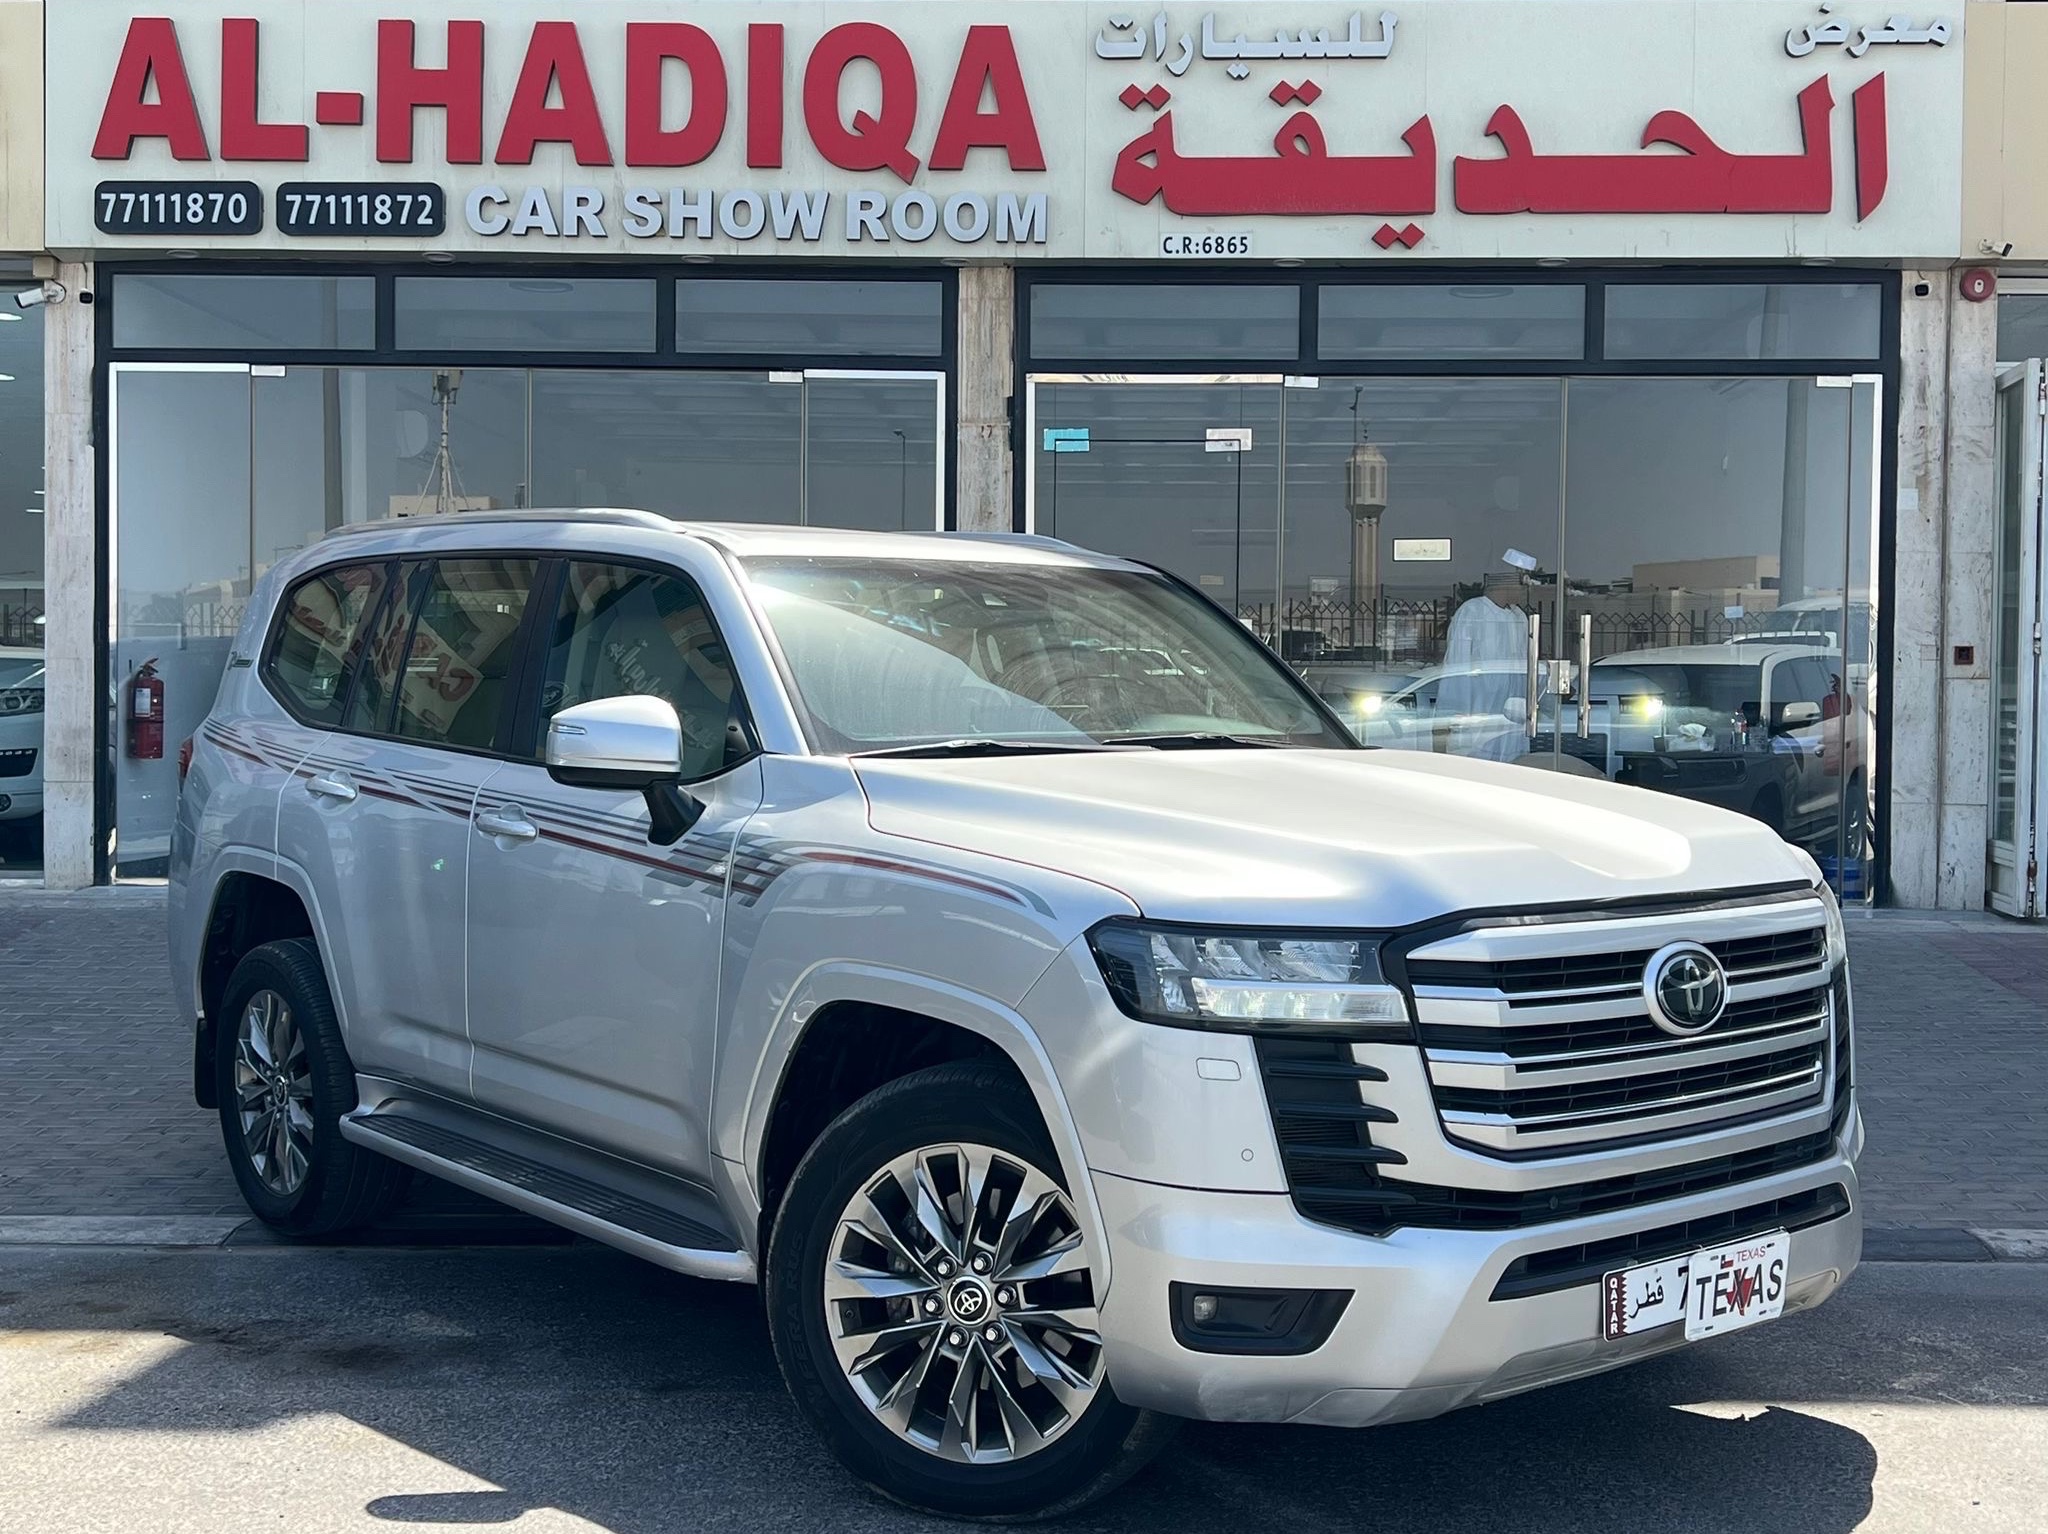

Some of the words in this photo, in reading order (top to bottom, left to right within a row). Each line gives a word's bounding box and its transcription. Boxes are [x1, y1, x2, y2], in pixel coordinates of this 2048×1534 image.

[1095, 10, 1399, 77] للسيارات
[1784, 3, 1952, 58] معرض
[91, 17, 1047, 185] AL-HADIQA
[1112, 71, 1888, 249] الحديقة
[100, 193, 248, 224] 77111870
[285, 194, 434, 226] 77111872
[465, 186, 607, 237] CAR
[623, 187, 829, 242] SHOW
[846, 190, 1048, 243] ROOM
[1162, 236, 1249, 255] C.R:6865
[1736, 1245, 1766, 1262] TEXAS
[1609, 1277, 1619, 1335] QATAR
[1628, 1276, 1665, 1319] قطر
[1695, 1258, 1784, 1321] TEXAS
